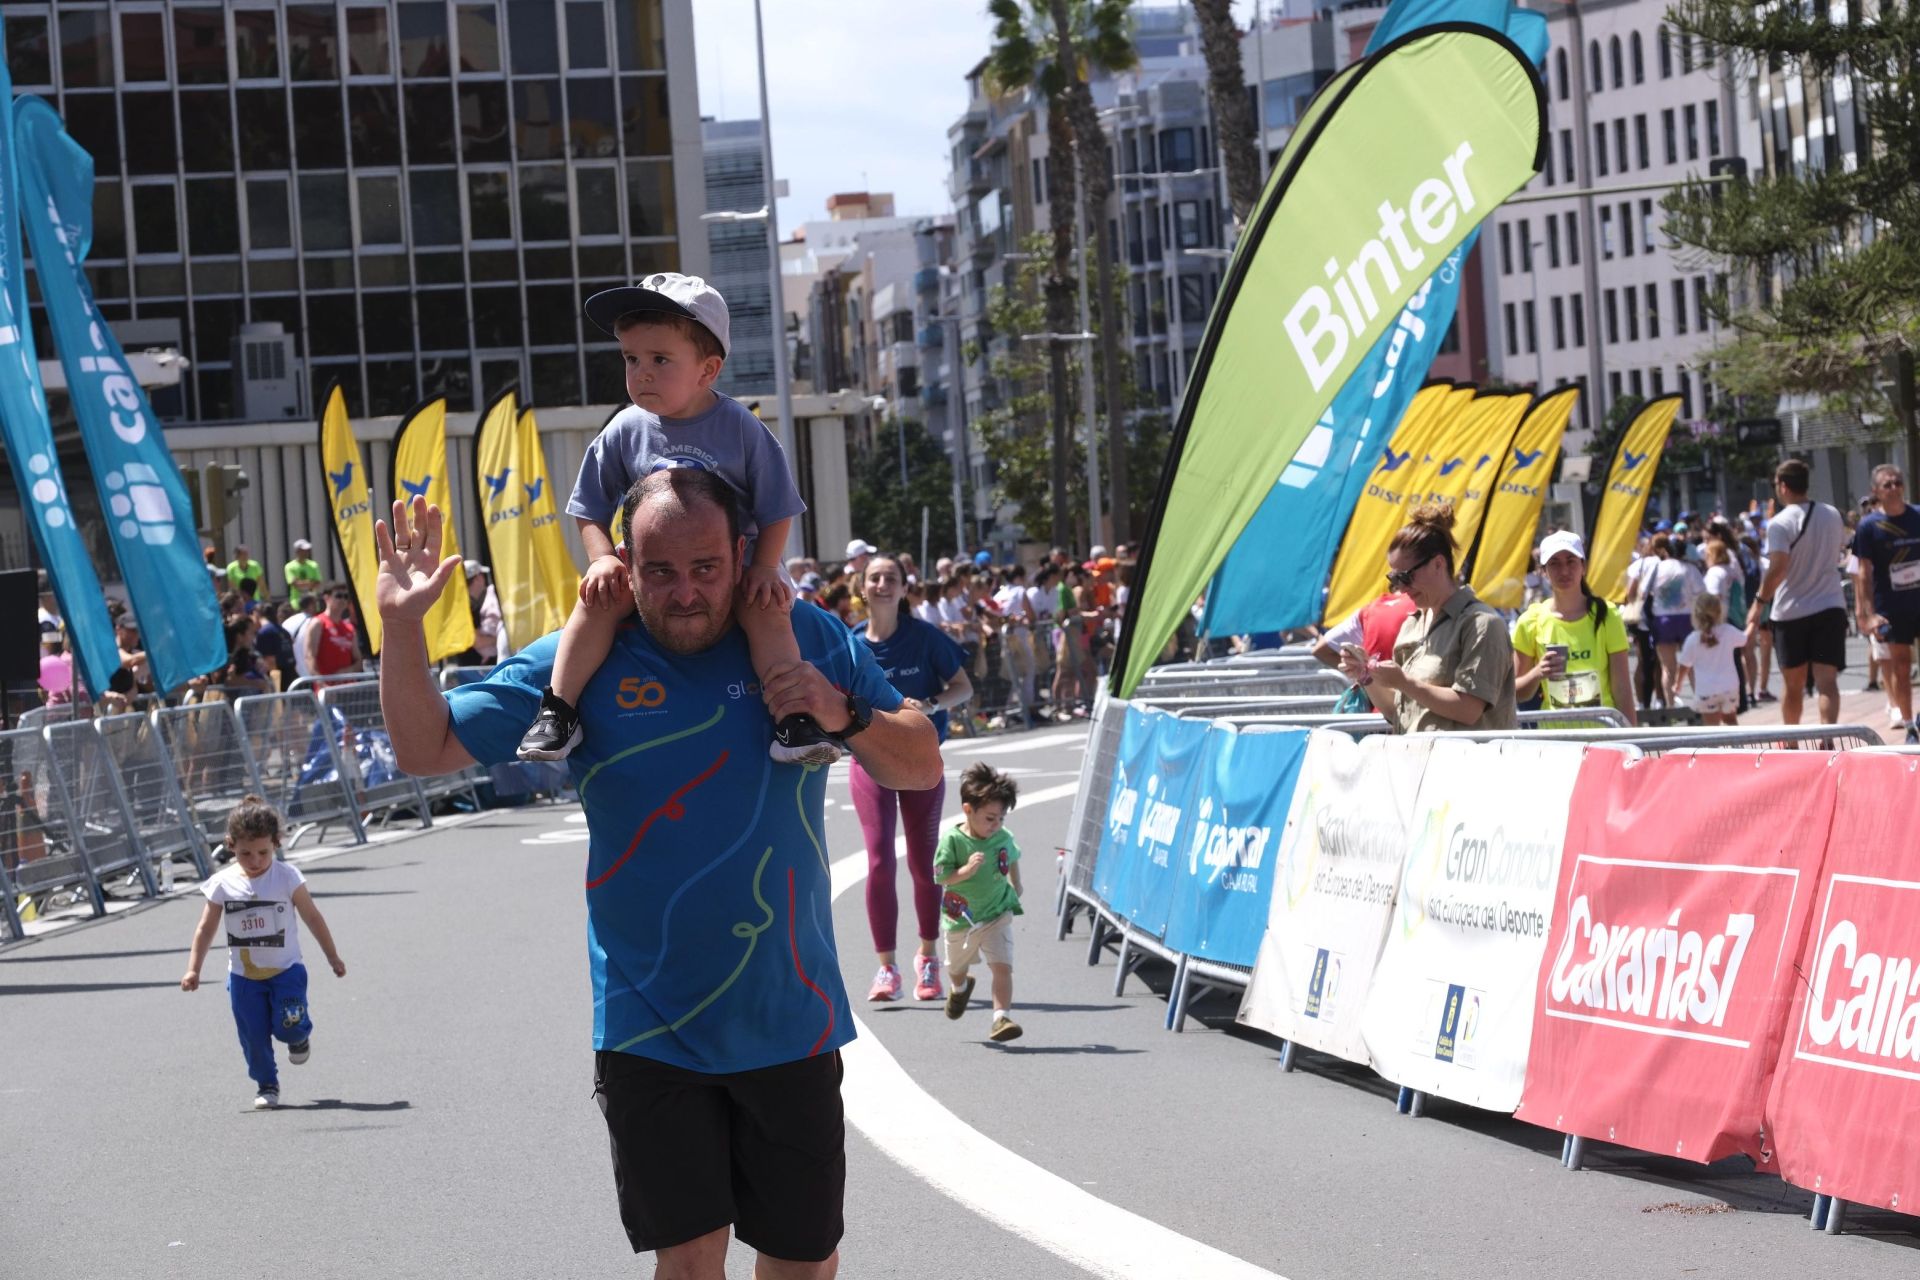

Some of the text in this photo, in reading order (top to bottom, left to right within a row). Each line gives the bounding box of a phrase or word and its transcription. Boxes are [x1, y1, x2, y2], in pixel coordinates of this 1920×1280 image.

[1282, 140, 1476, 393] Binter
[662, 444, 719, 470] AMERICA
[340, 502, 368, 519] DIS
[616, 677, 666, 709] 50
[727, 680, 765, 699] glo
[241, 917, 265, 931] 3310
[1500, 900, 1544, 942] Deporte
[1551, 896, 1755, 1027] Canarias7
